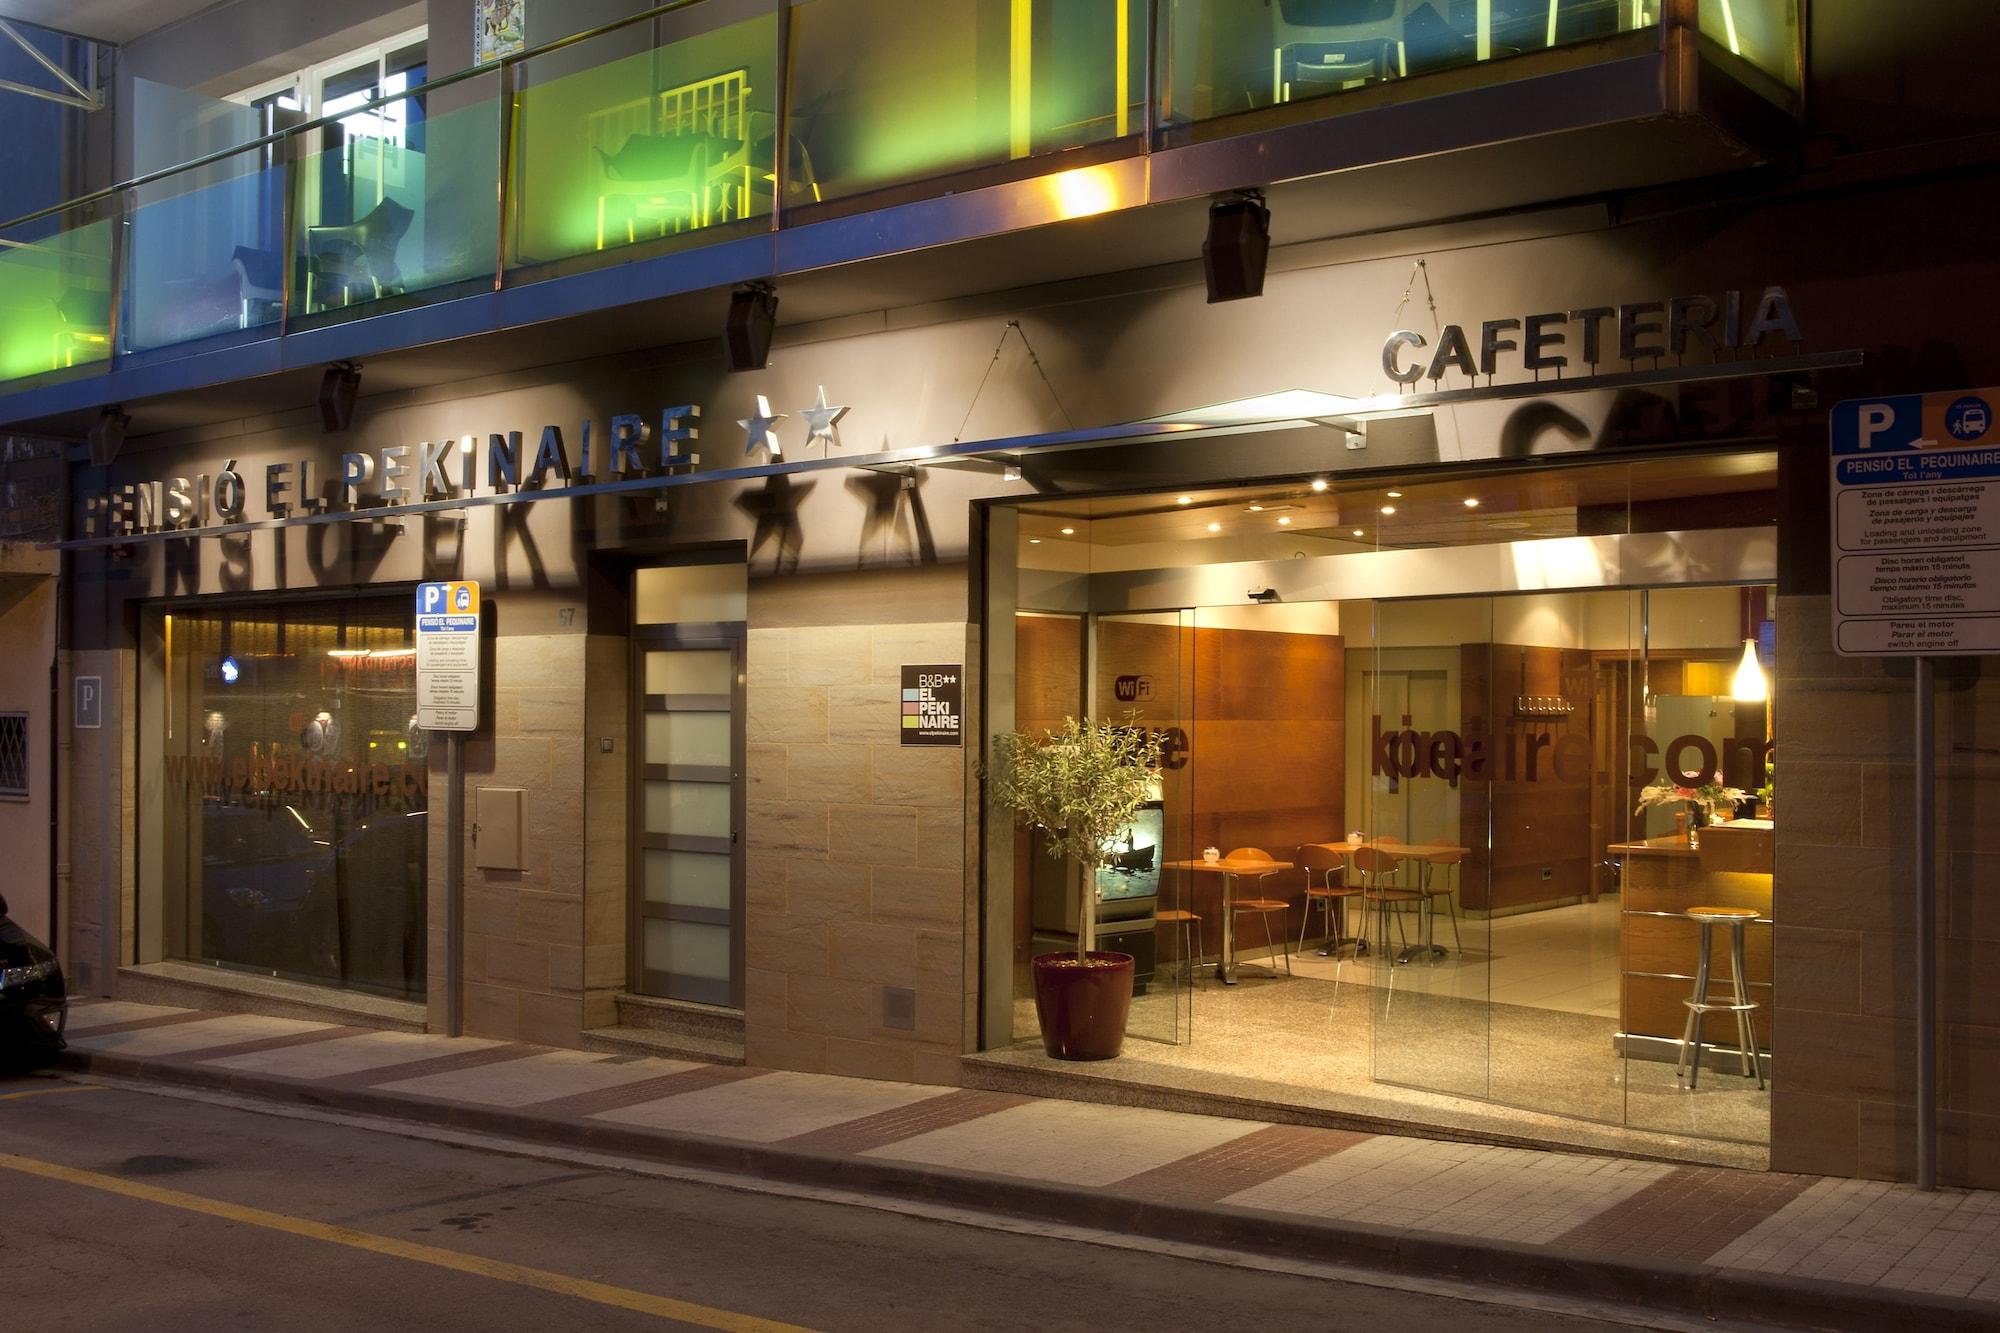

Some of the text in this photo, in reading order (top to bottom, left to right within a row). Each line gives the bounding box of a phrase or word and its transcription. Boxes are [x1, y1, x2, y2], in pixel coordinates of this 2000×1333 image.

[1382, 286, 1805, 383] CAFETERIA
[1858, 403, 1896, 449] P
[84, 404, 701, 534] PENSIÓ EL PEKINAIRE
[1846, 452, 2000, 474] PENSIÓ EL PEQUINAIRE
[1903, 471, 1943, 480] Tot l'any
[1861, 491, 1883, 499] Zona
[1866, 498, 1878, 506] de
[1879, 496, 1925, 506] passatgers
[1932, 494, 1980, 503] equipatges
[1869, 509, 1890, 518] Zona
[1904, 507, 1929, 517] carga
[1937, 505, 1978, 515] descarga
[1871, 517, 1883, 525] de
[1883, 516, 1925, 525] pasajeros
[1933, 513, 1975, 523] equipajes
[1864, 530, 1897, 539] Loading
[1899, 528, 1916, 536] and
[1917, 526, 1959, 536] unloading
[1860, 532, 1986, 546] for passengers and equipment
[1881, 557, 1899, 565] Disc
[1926, 555, 1965, 564] obligatori
[1875, 565, 1901, 573] temps
[1932, 563, 1941, 571] 15
[1873, 573, 1972, 585] Disco horario obligatorio
[1869, 584, 1898, 593] tiempo
[1932, 582, 1942, 590] 15
[1943, 581, 1977, 590] minutos
[425, 586, 439, 613] P
[1882, 595, 1923, 605] Obligatory
[1924, 594, 1943, 602] time
[1881, 601, 1965, 611] maximum 15 minutes
[1890, 621, 1915, 629] Pareu
[1928, 620, 1955, 628] motor
[1891, 630, 1954, 638] Parar el motor
[1917, 640, 1945, 649] engine
[1947, 639, 1959, 647] off
[918, 674, 943, 688] B&B
[81, 684, 94, 711] P
[919, 688, 936, 702] EL
[919, 701, 950, 715] PEKI
[919, 715, 959, 729] NAIRE
